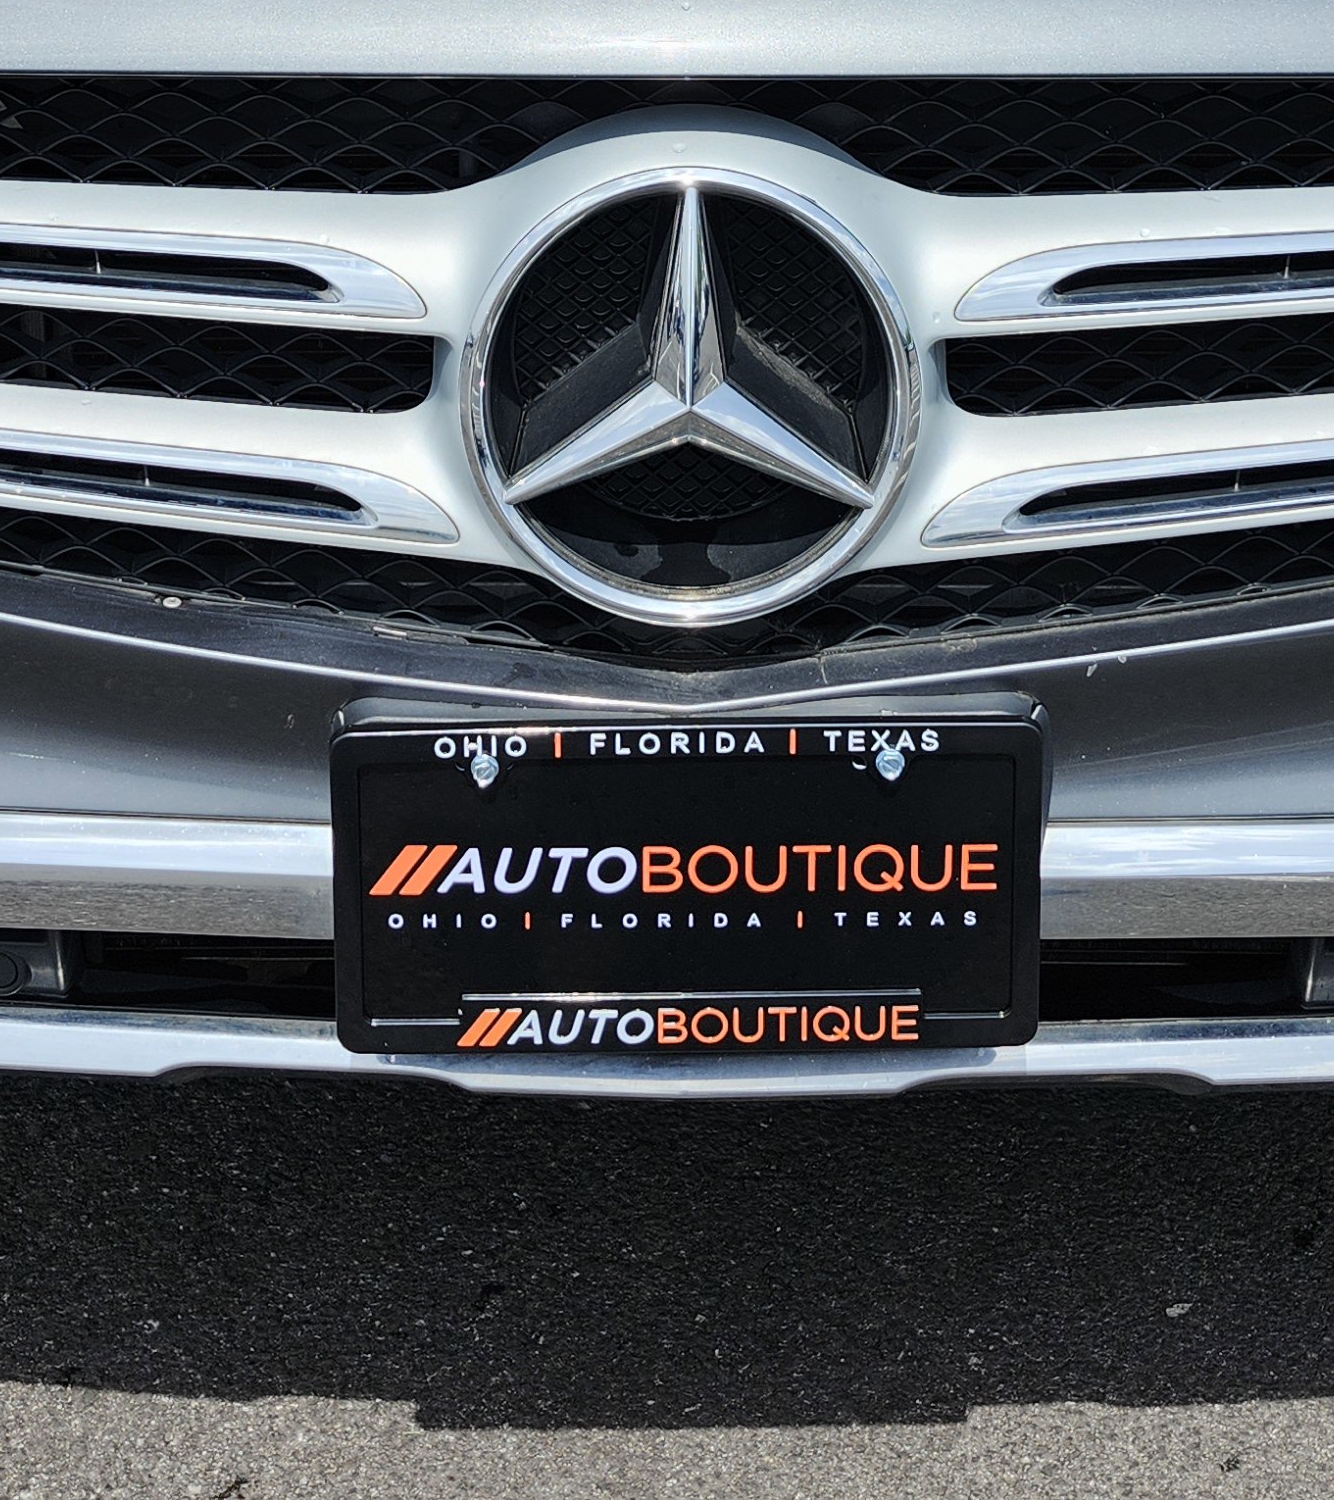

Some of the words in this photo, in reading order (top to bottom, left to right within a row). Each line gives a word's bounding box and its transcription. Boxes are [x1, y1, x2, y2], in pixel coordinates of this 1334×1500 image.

[433, 734, 528, 759] OHIO
[588, 729, 766, 756] FLORIDA
[822, 727, 940, 753] TEXAS
[437, 843, 999, 895] AUTOBOUTIQUE
[388, 912, 497, 930] OHIO
[560, 911, 762, 929] FLORIDA
[833, 910, 978, 927] TEXAS
[507, 1003, 920, 1047] AUTOBOUTIQUE
